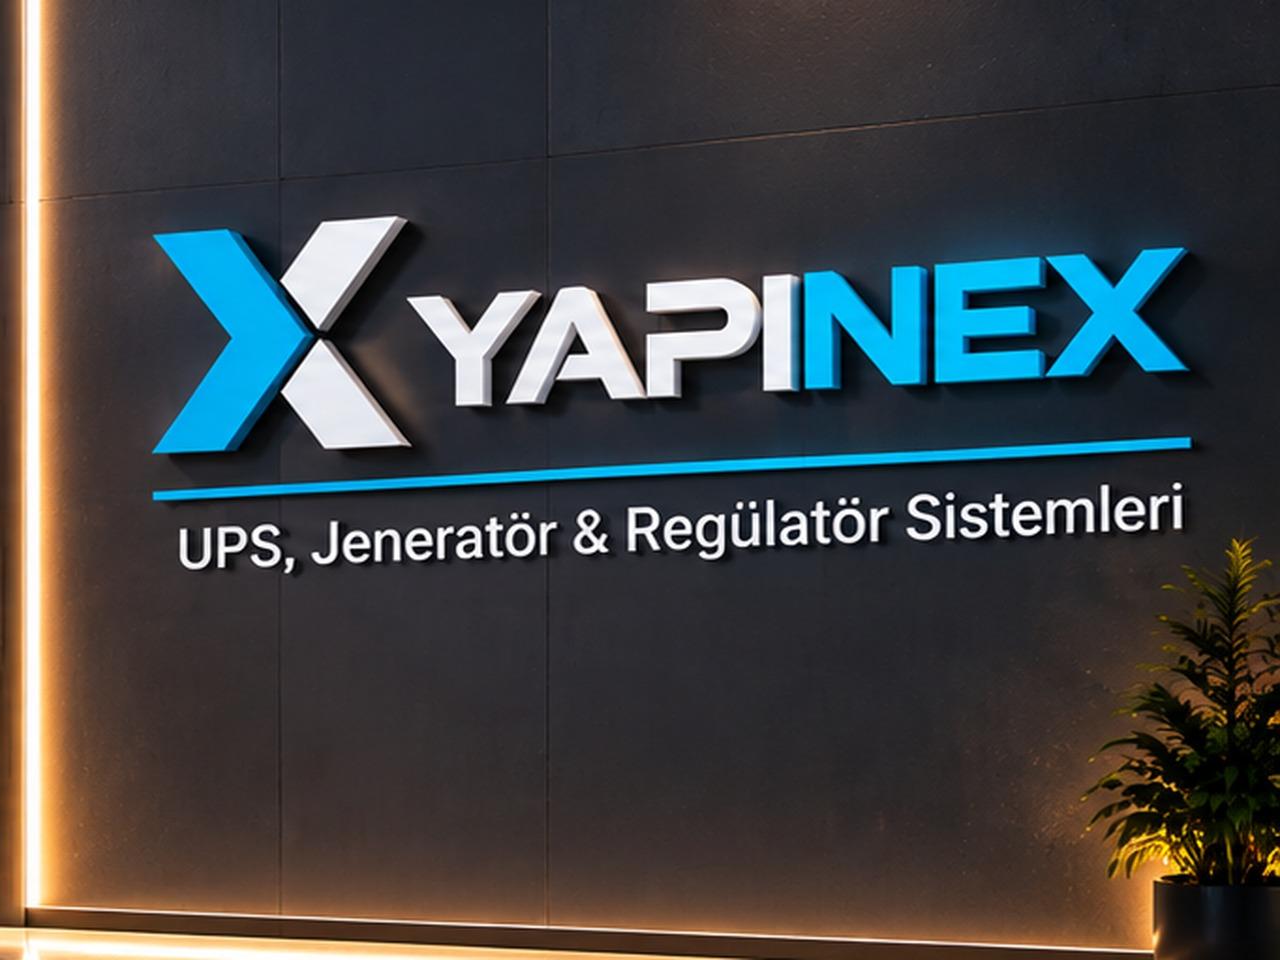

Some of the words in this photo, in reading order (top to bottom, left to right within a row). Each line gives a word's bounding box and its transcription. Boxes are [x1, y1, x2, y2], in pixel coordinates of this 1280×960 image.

[406, 246, 1189, 408] YAPINEX
[178, 522, 296, 575] UPS,
[310, 510, 558, 566] Jeneratör
[572, 507, 610, 556] &
[626, 496, 890, 561] Regülatör
[905, 481, 1184, 542] Sistemleri
